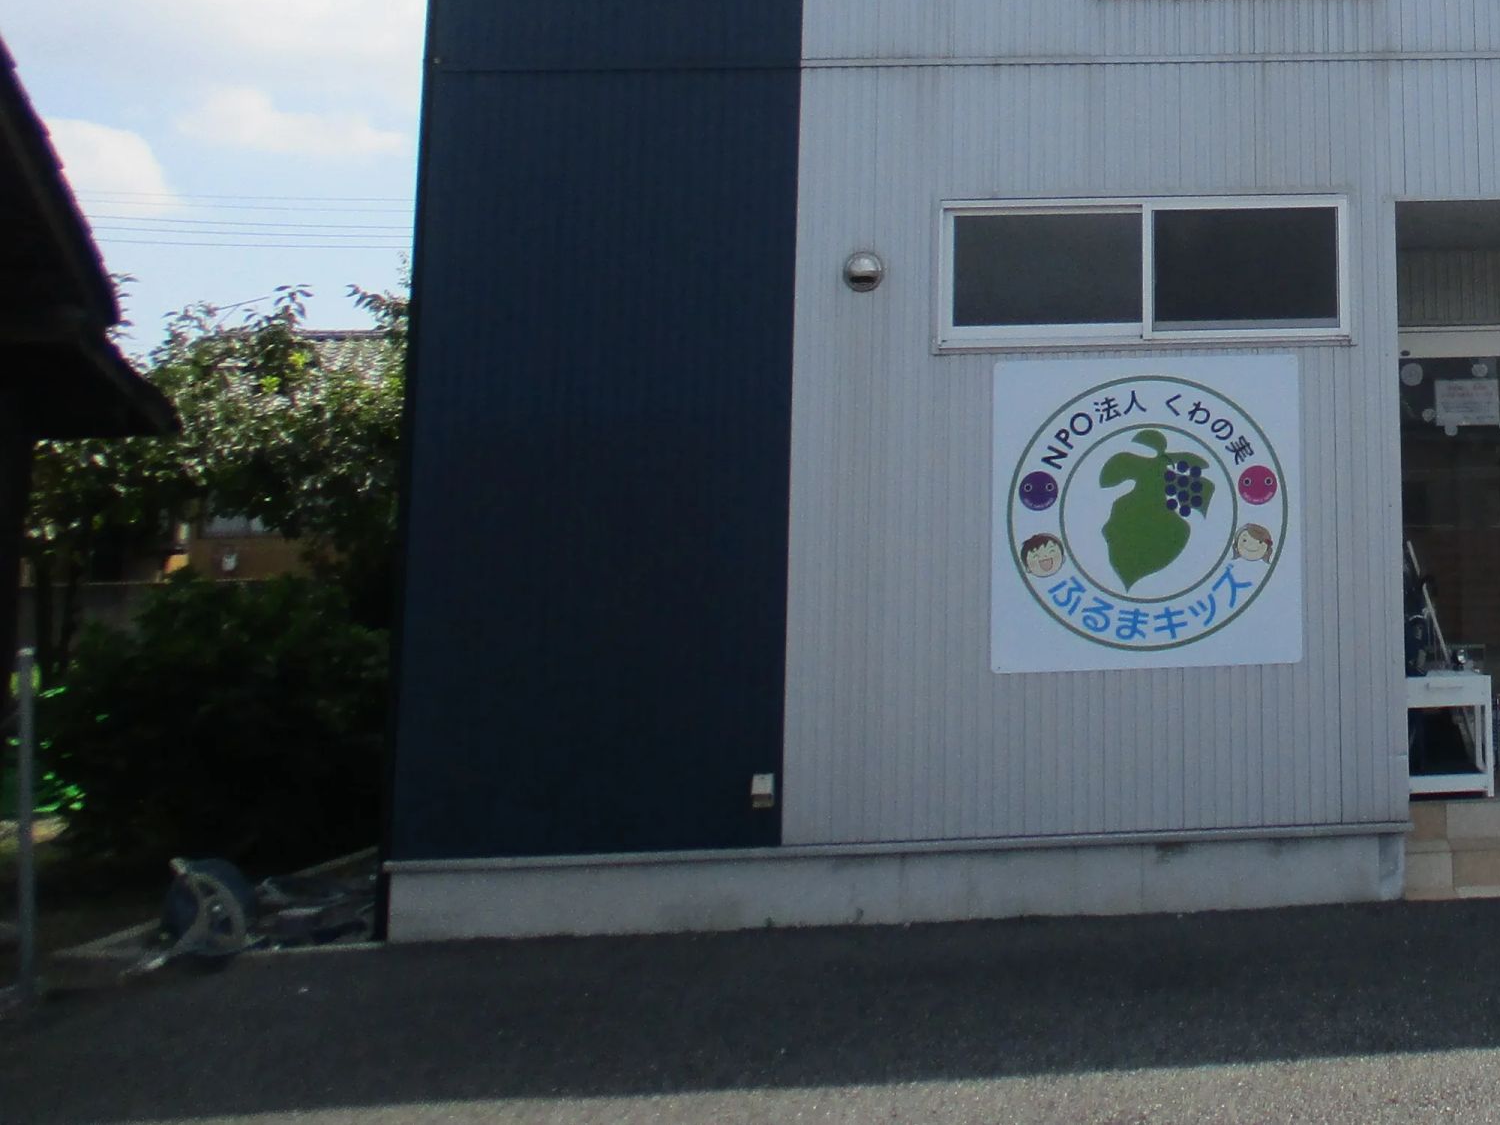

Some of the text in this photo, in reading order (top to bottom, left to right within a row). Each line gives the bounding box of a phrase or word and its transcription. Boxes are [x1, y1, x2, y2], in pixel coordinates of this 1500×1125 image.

[1040, 390, 1255, 470] NPO法人 くわの実
[1048, 564, 1252, 639] ふるまキッズ
